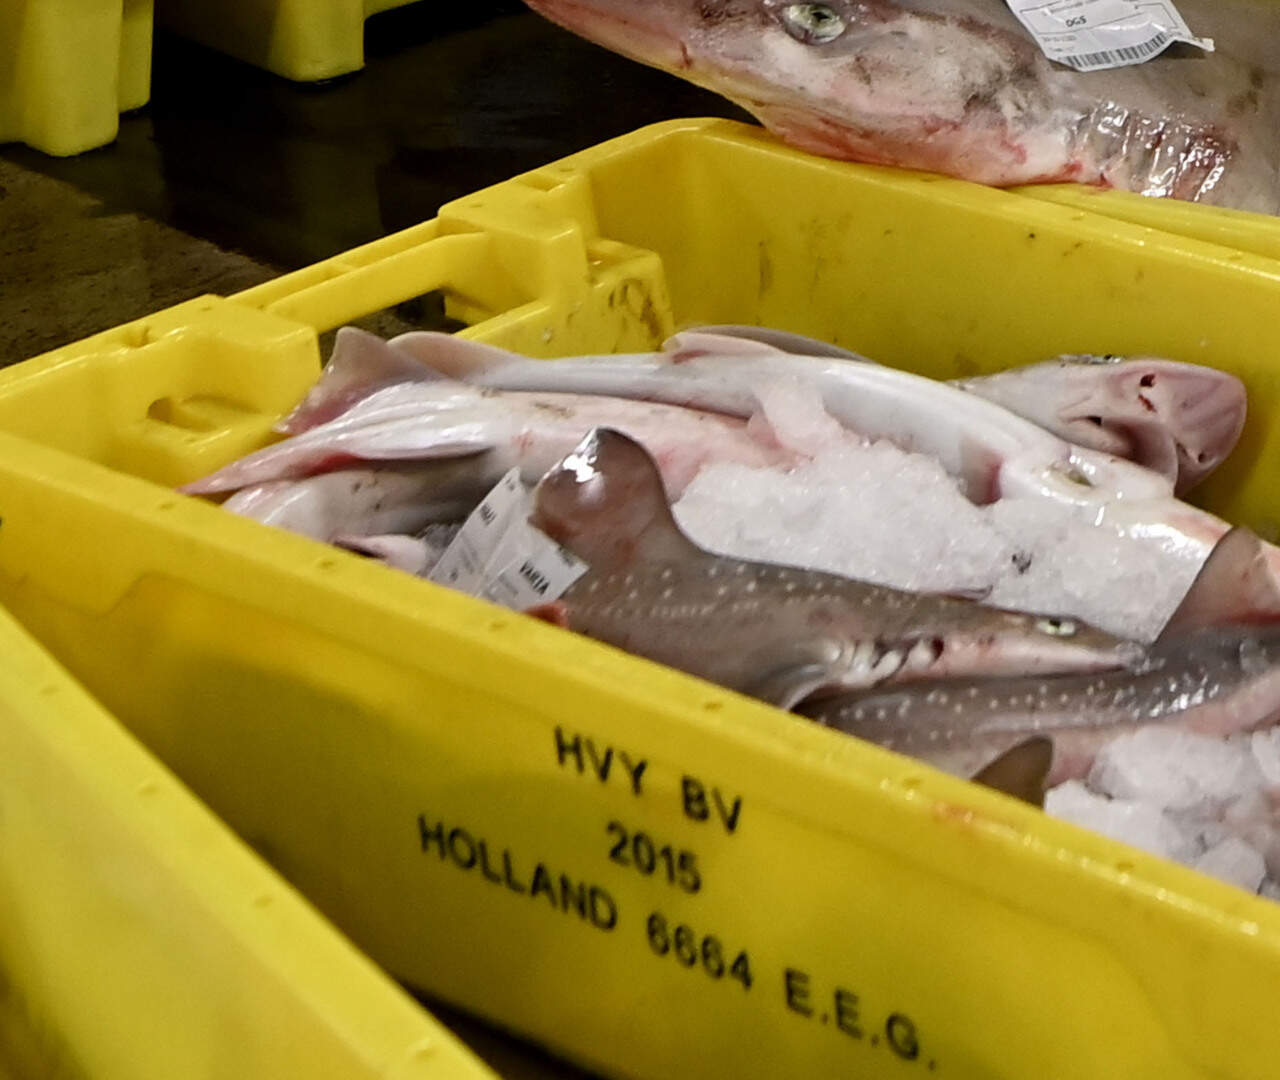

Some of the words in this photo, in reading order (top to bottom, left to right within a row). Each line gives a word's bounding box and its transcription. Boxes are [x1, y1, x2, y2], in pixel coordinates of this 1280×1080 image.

[554, 727, 648, 797] HVY
[681, 776, 742, 834] BV
[607, 822, 702, 895] 2015
[417, 814, 618, 932] HOLLAND
[646, 911, 754, 991] 6664
[785, 968, 937, 1070] E.E.G.
